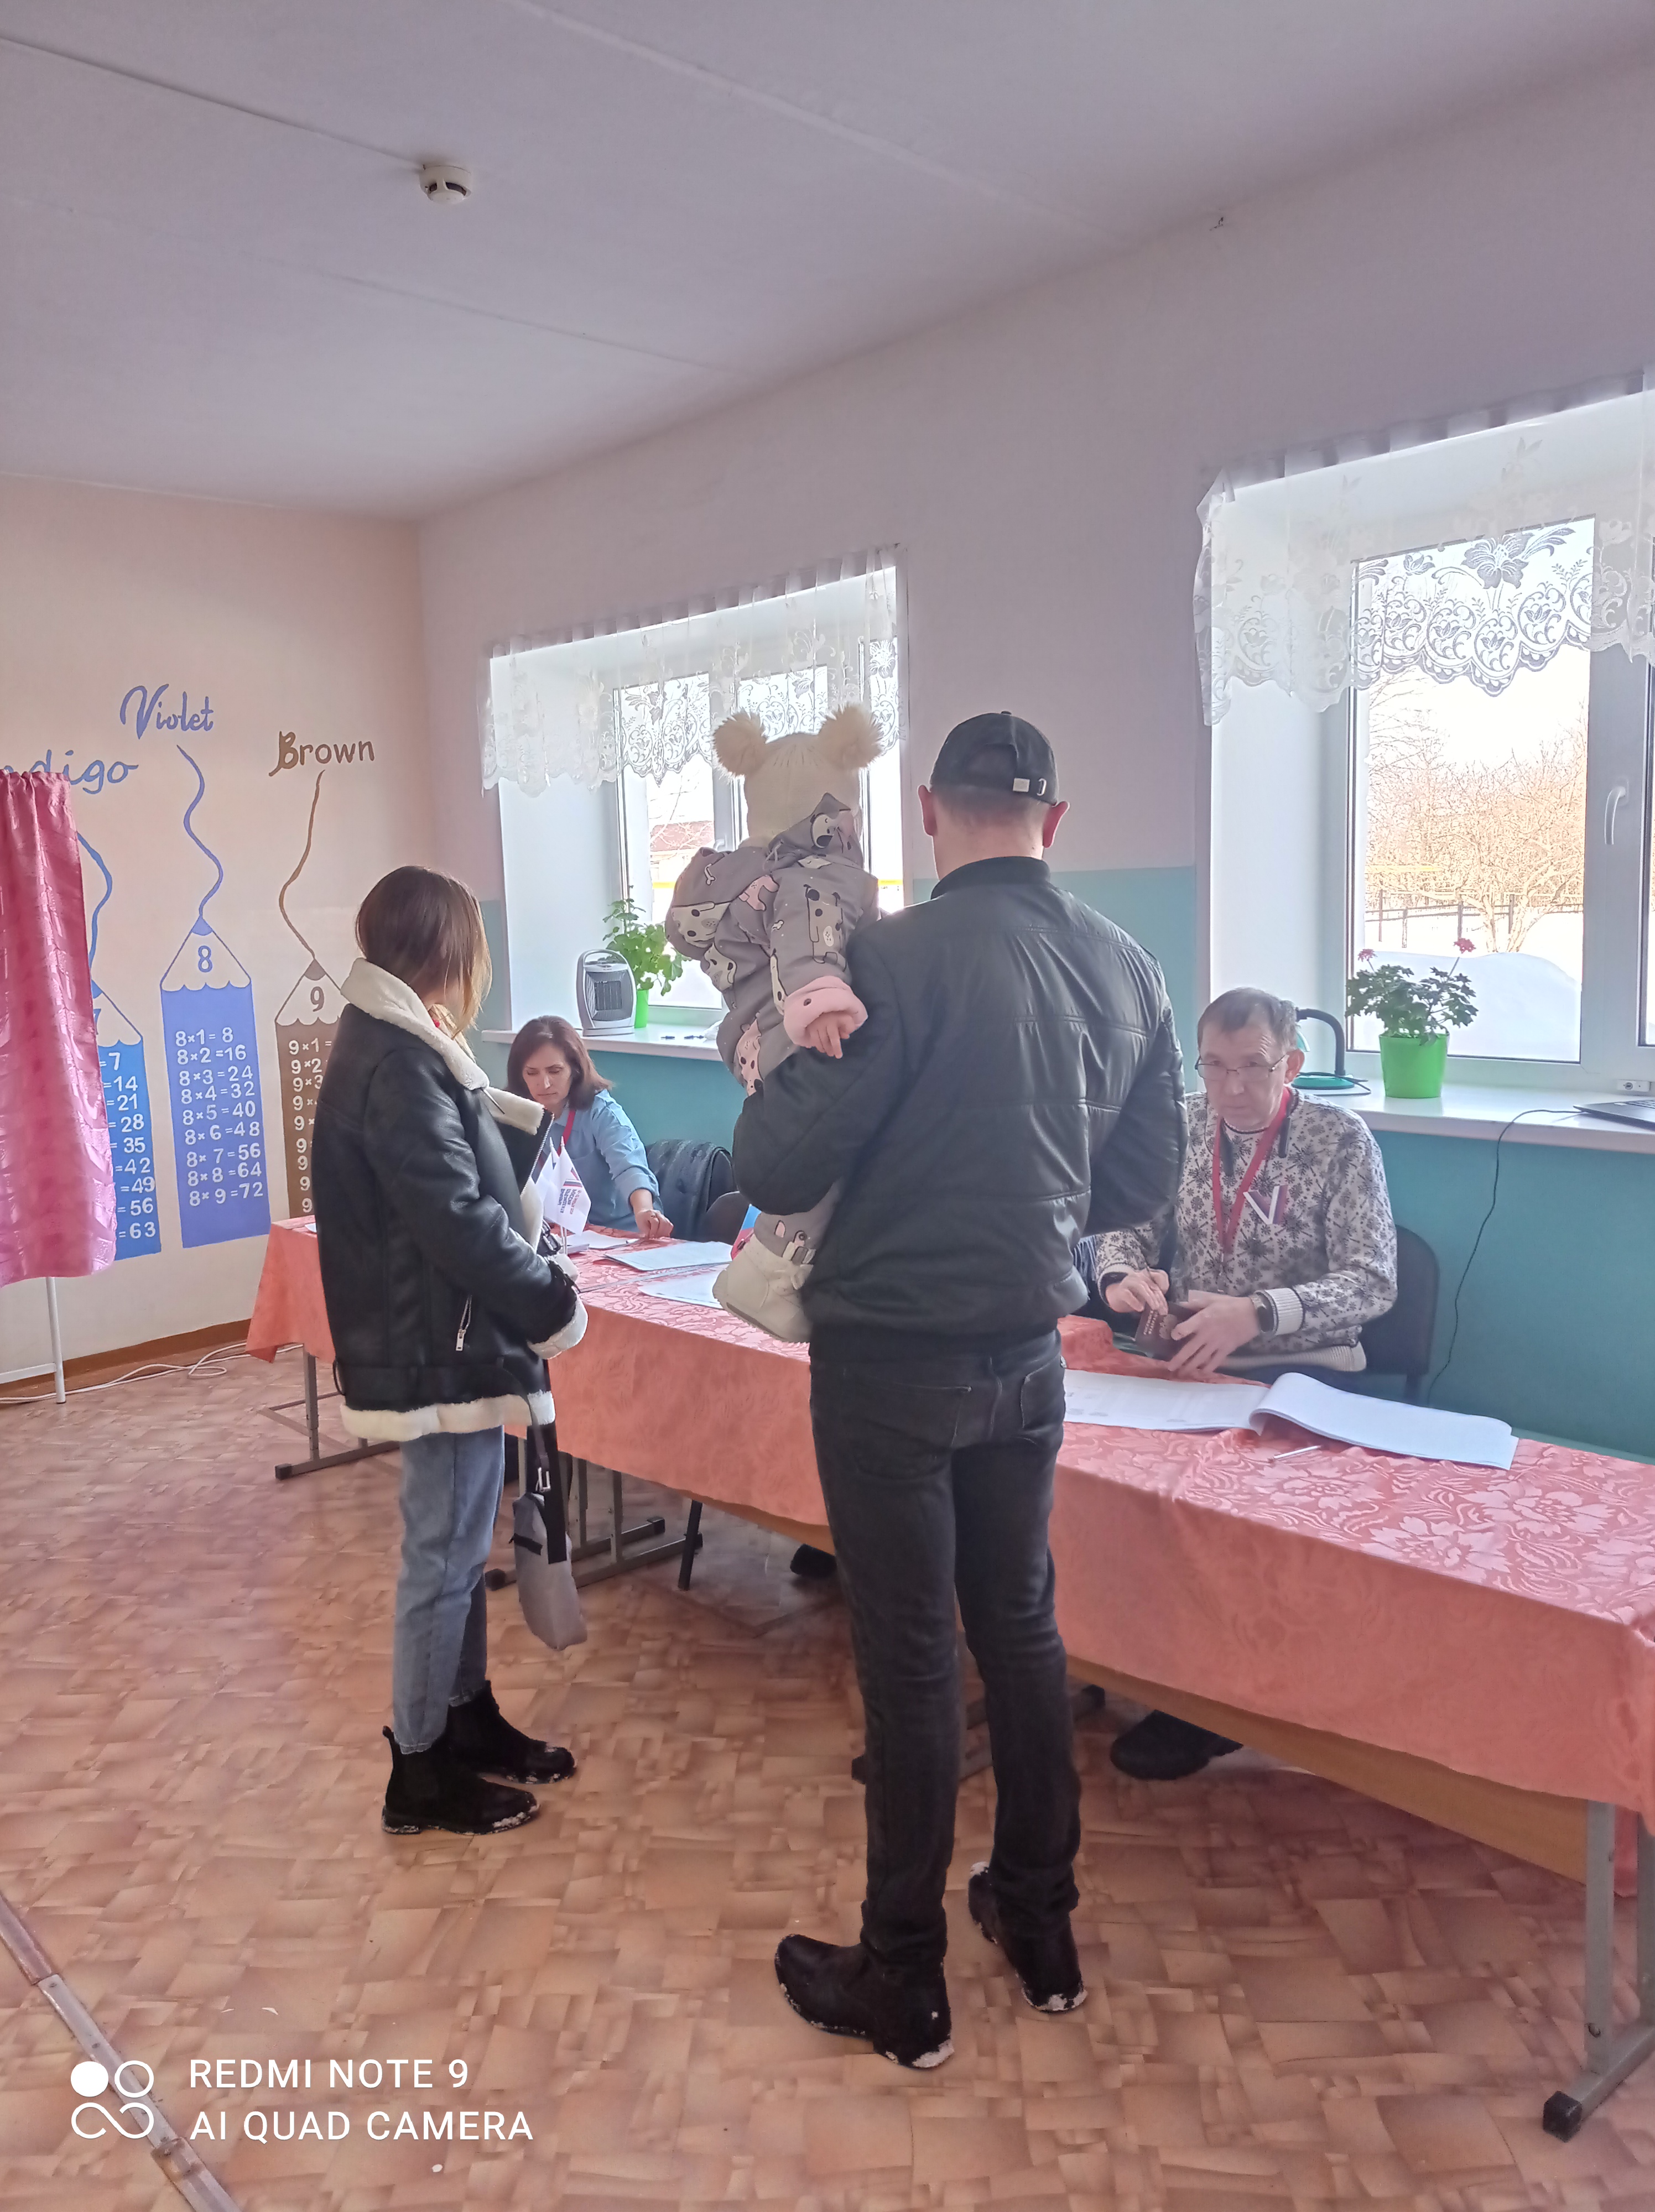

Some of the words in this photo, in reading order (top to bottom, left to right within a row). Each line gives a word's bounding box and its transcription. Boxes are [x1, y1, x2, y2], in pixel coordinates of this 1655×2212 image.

[119, 684, 214, 739] Violet
[268, 731, 375, 776] Brown
[197, 945, 213, 973] 8
[310, 986, 325, 1012] 9
[297, 1155, 308, 1171] 9
[300, 1176, 310, 1191] 9
[302, 1198, 313, 1213] 9
